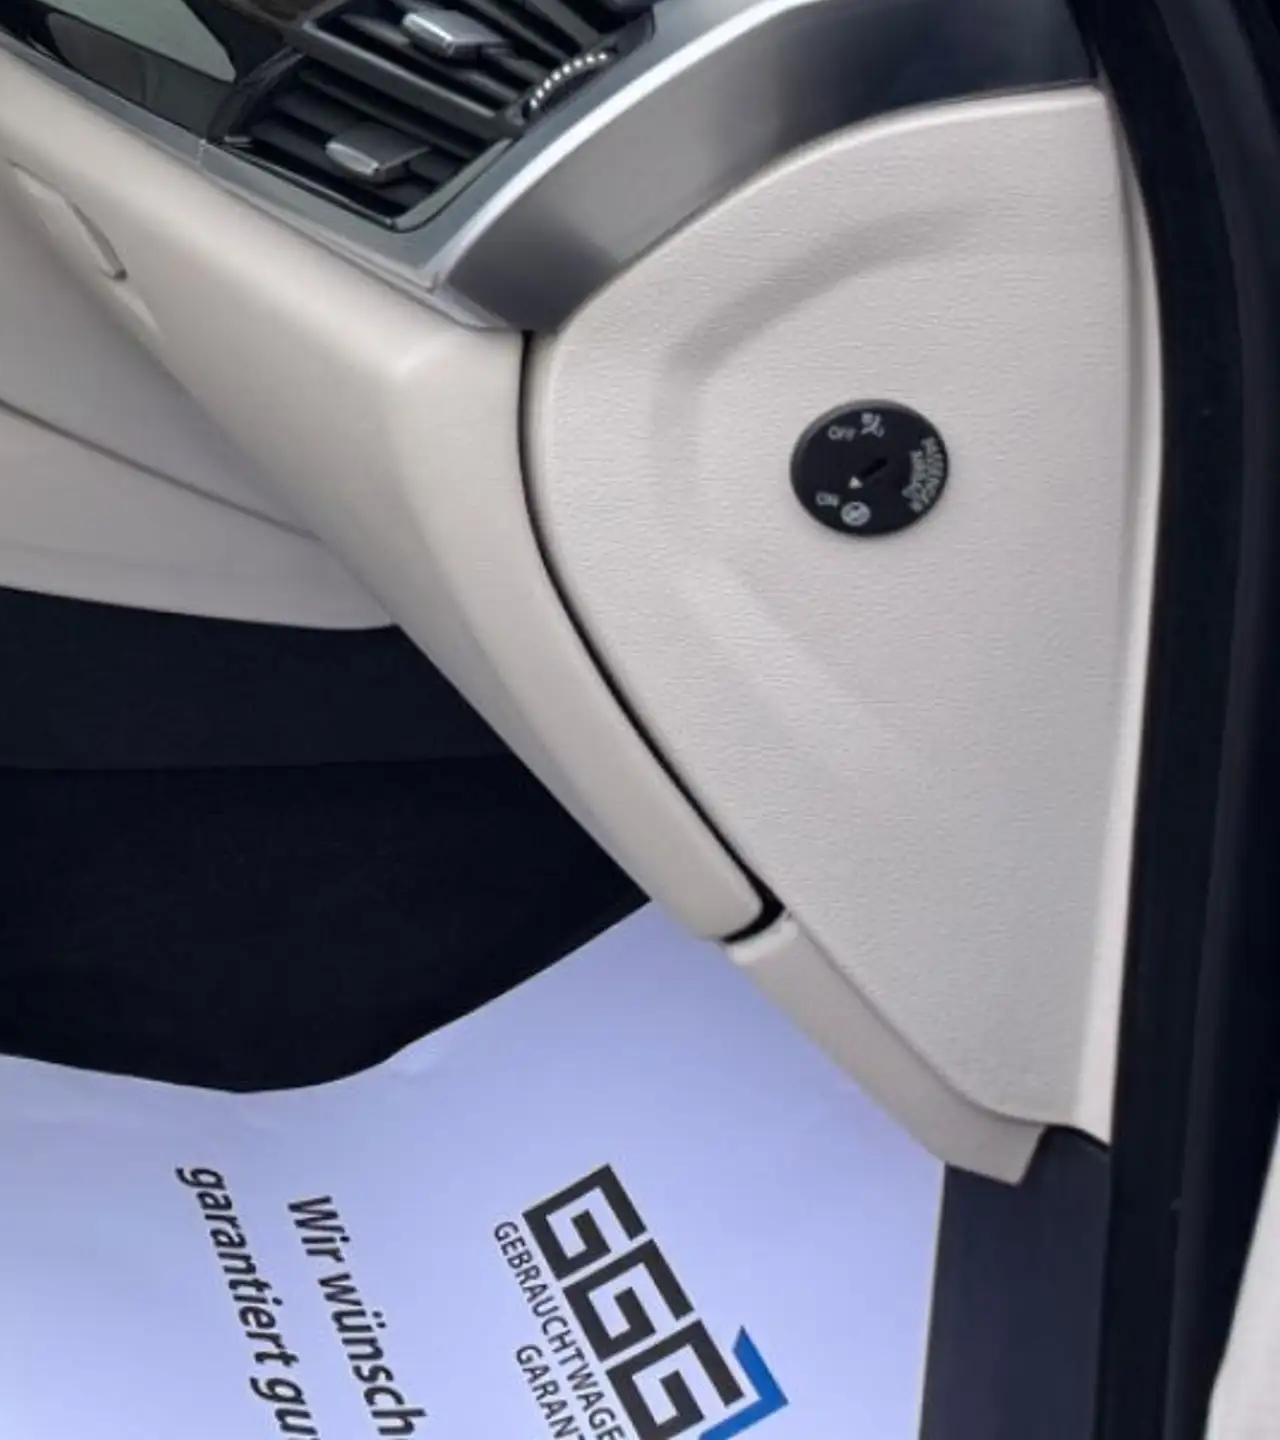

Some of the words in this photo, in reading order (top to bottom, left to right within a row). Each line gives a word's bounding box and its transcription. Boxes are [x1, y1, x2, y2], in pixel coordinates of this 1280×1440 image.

[174, 1166, 300, 1367] garantiert
[287, 1195, 350, 1263] Wir
[521, 1163, 746, 1440] GGG
